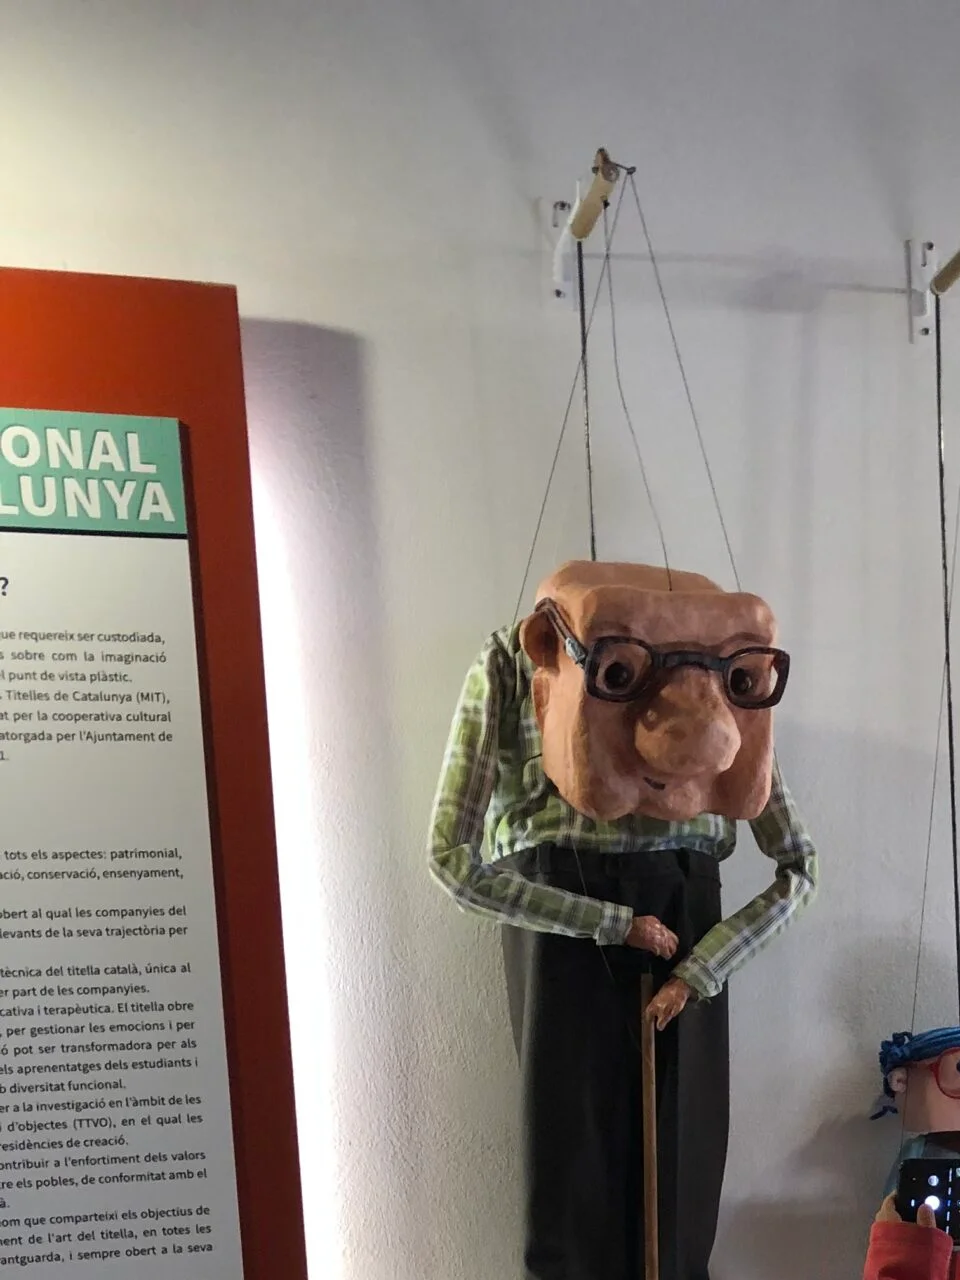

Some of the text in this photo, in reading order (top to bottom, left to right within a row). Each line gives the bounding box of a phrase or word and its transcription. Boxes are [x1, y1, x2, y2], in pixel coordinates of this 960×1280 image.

[18, 630, 165, 643] requereix ser custodiada,
[11, 650, 166, 664] sobre com la imaginació
[5, 690, 170, 704] Titelles de Catalunya (MIT),
[56, 730, 172, 744] per l'Ajuntament de
[4, 848, 182, 862] tots els aspectes: patrimonial,
[27, 868, 183, 880] conservació, ensenyament,
[31, 905, 186, 920] al qual les companyies del
[46, 965, 63, 976] del
[67, 965, 100, 975] titella
[104, 964, 142, 975] català,
[145, 963, 176, 974] única
[180, 962, 191, 973] al
[43, 1001, 194, 1018] terapèutica. El titella obre
[14, 1038, 197, 1058] pot ser transformadora per als
[17, 1058, 192, 1076] aprenentatges dels estudiants
[9, 1079, 126, 1093] diversitat funcional.
[7, 1113, 203, 1132] d'objectes (TTVO), en el qual les
[64, 1150, 206, 1167] l'enfortiment dels valors
[24, 1206, 210, 1228] que comparteixi els objectius de
[28, 1233, 43, 1244] de
[48, 1232, 72, 1243] l'art
[77, 1230, 95, 1241] del
[100, 1228, 138, 1240] titella,
[162, 1226, 190, 1236] totes
[196, 1224, 212, 1234] les
